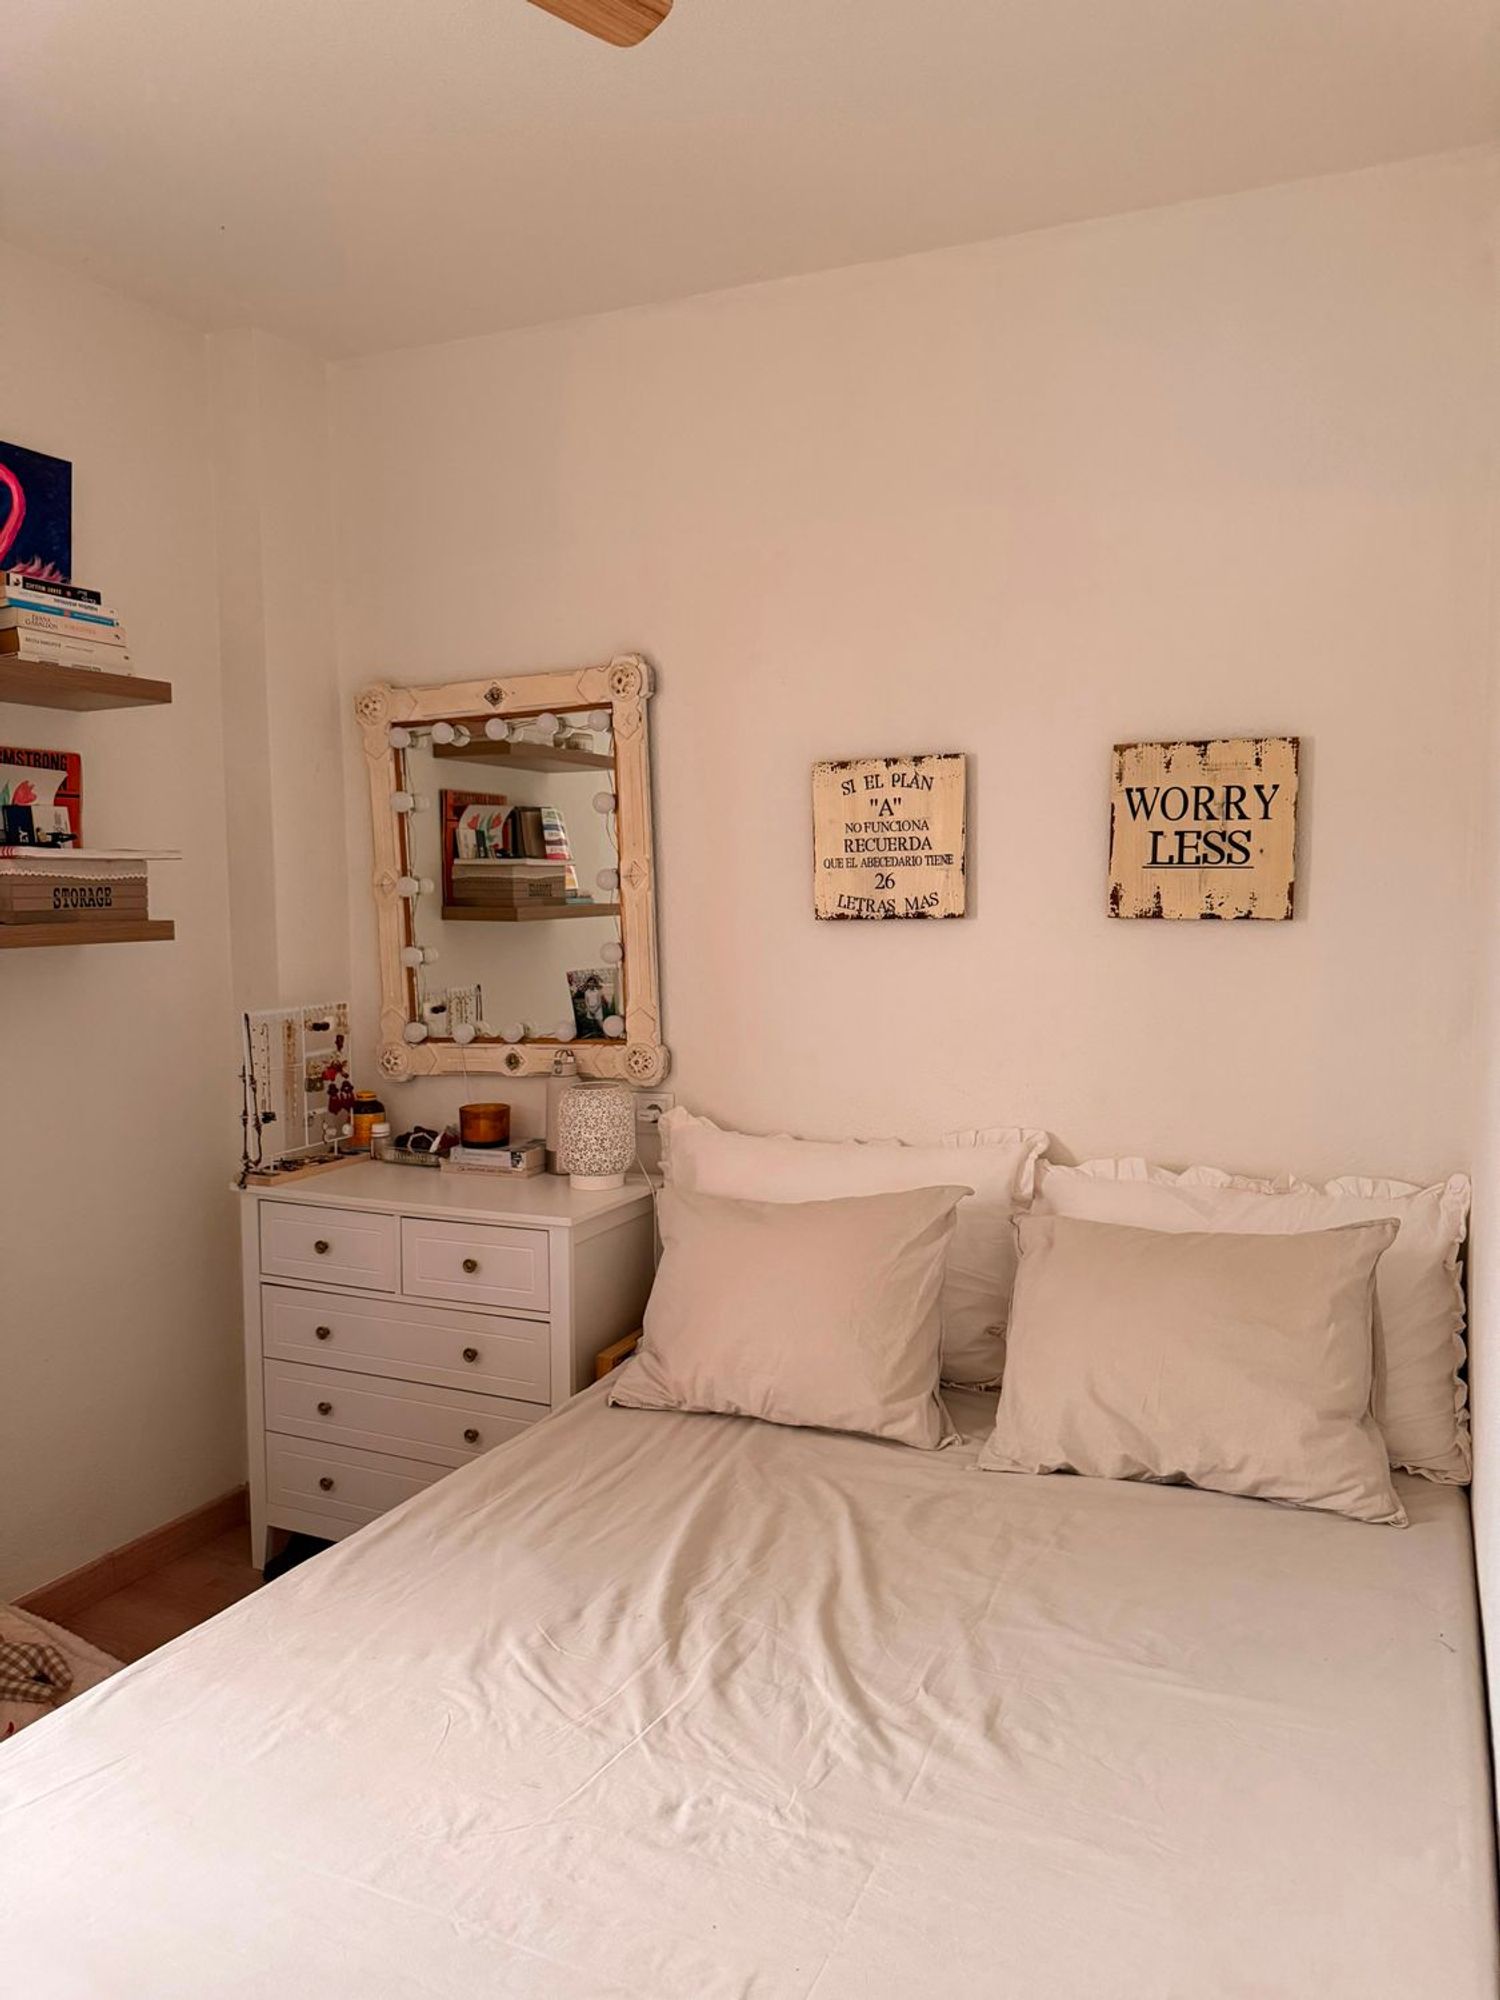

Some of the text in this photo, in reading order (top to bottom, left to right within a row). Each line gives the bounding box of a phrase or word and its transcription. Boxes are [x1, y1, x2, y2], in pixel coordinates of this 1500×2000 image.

[0, 748, 67, 771] MSTRONG
[841, 779, 857, 796] SI
[863, 774, 884, 790] EL
[870, 797, 902, 817] "A"
[1124, 783, 1280, 822] WORRY
[845, 819, 930, 834] NO FUNCIONA
[844, 836, 932, 853] RECUERDA
[1146, 829, 1252, 866] LESS
[823, 853, 954, 869] QUE EL ABECEDARIO TIENE
[874, 872, 896, 890] 26
[53, 887, 112, 909] STORAGE
[837, 891, 940, 913] LETRAS MAS
